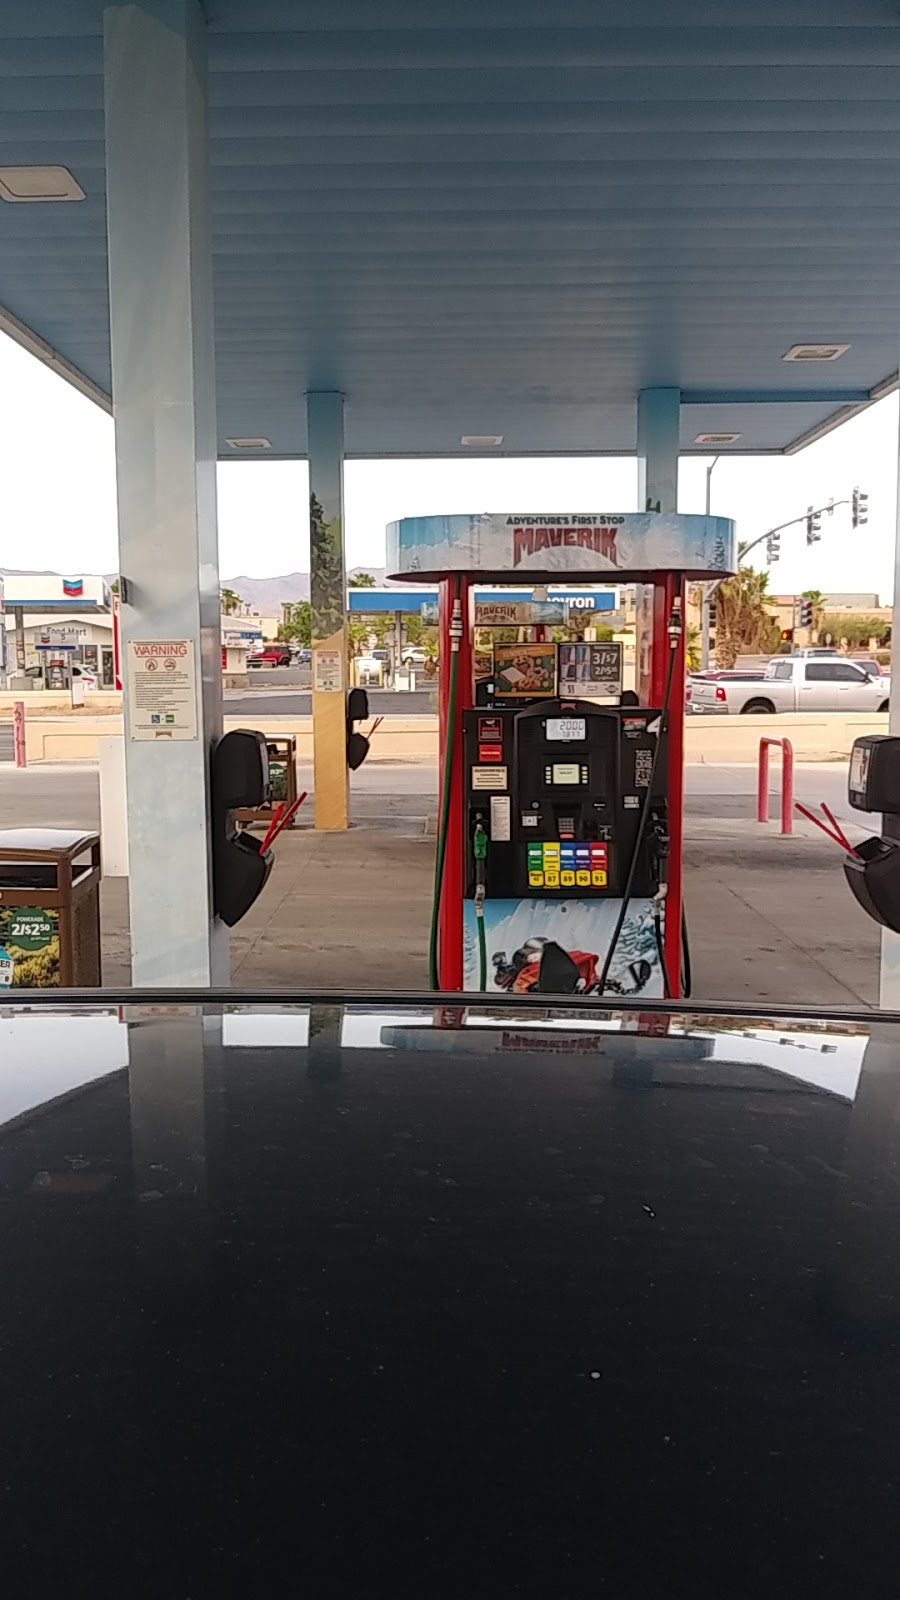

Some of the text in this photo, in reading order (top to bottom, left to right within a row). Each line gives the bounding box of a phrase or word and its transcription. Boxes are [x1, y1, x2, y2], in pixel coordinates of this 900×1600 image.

[513, 528, 619, 568] MAVERIK
[134, 645, 187, 656] WARNING
[592, 652, 618, 665] 3/$7
[0, 960, 10, 968] ER
